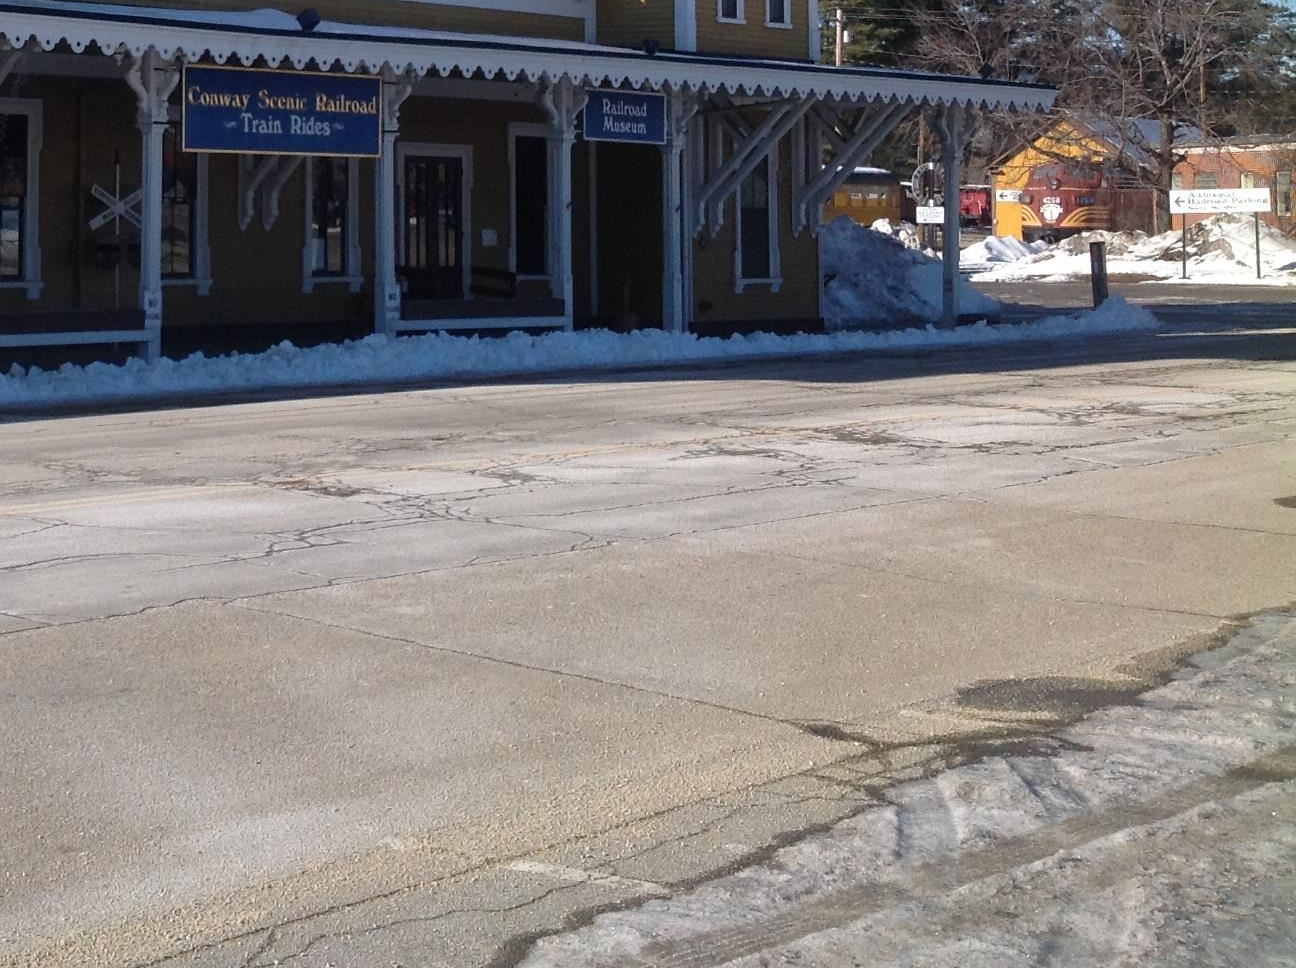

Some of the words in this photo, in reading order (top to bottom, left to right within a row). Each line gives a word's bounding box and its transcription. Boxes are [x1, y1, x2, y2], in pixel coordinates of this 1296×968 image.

[188, 85, 251, 110] Conway
[258, 89, 308, 111] Scenic
[316, 93, 377, 114] Railroad
[603, 98, 647, 117] Railroad
[241, 113, 283, 134] Train
[290, 115, 331, 136] Rides
[603, 116, 647, 134] Museum
